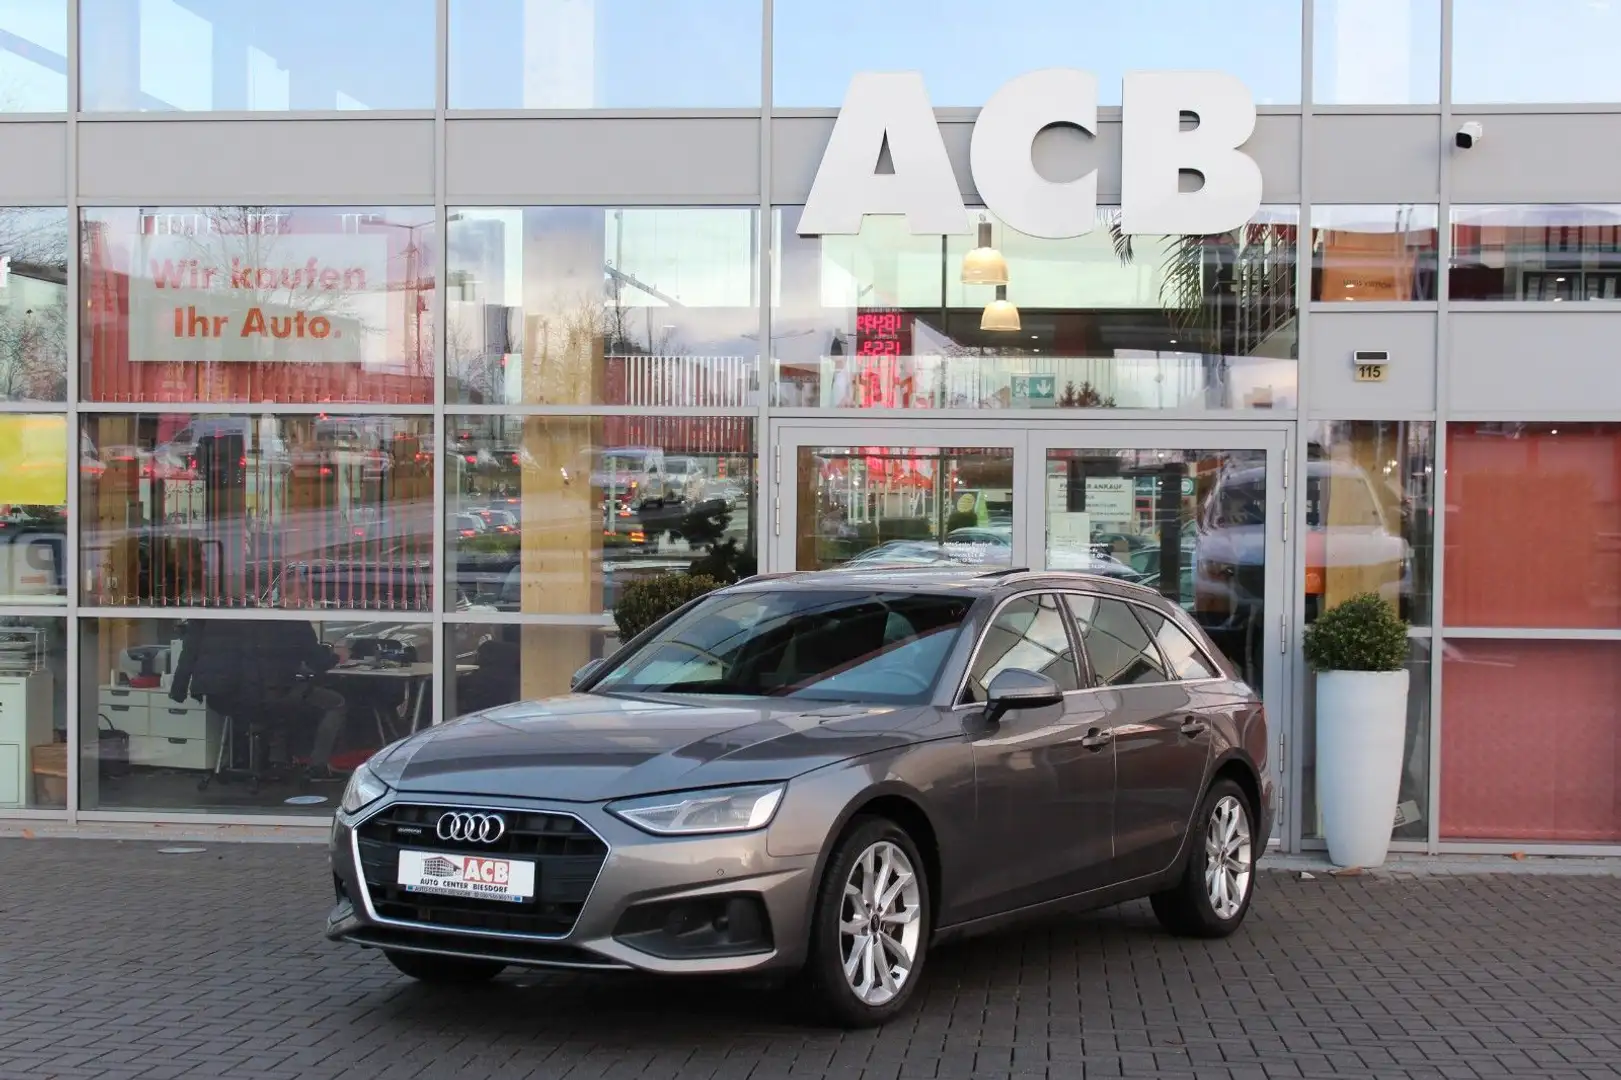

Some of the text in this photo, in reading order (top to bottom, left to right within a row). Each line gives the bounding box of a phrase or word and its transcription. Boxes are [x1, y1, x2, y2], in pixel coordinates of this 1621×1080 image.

[796, 68, 1262, 239] ACB
[151, 256, 365, 290] Wir kaufen
[174, 306, 342, 339] Ihr Auto.
[1359, 365, 1380, 378] 115
[420, 878, 508, 893] AUTO CENTER BIESDORF
[464, 858, 509, 884] ACB
